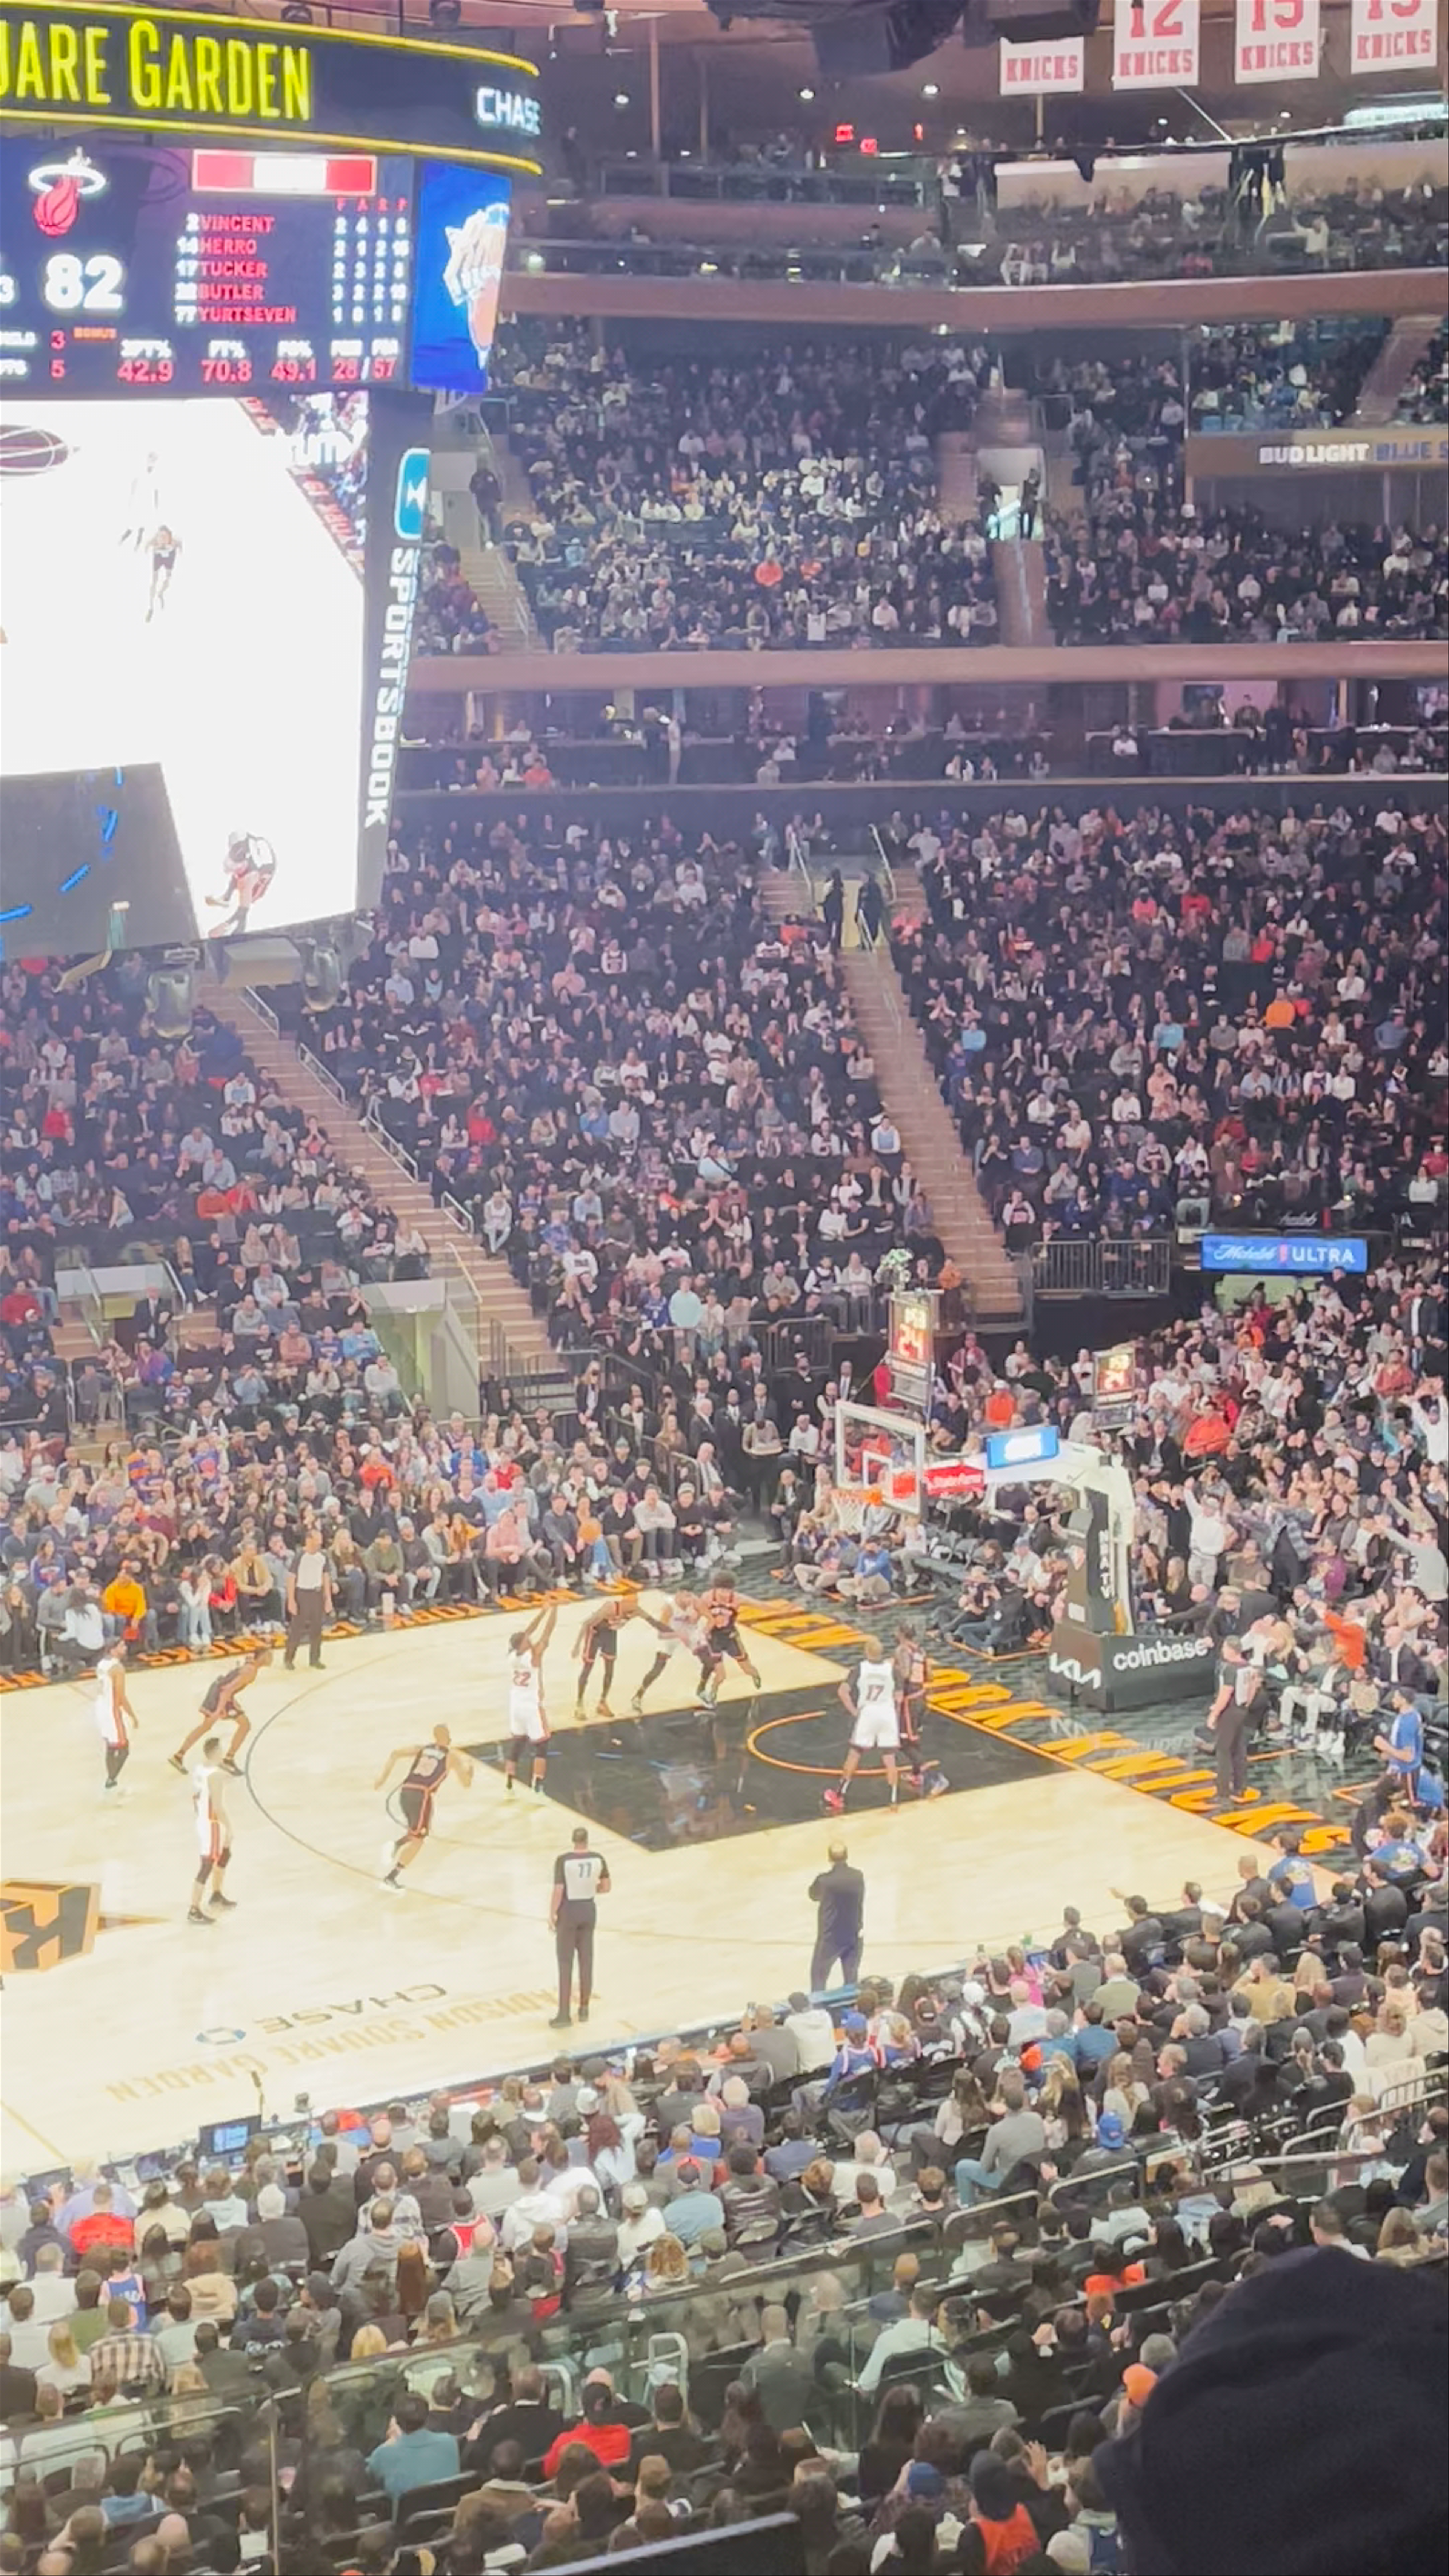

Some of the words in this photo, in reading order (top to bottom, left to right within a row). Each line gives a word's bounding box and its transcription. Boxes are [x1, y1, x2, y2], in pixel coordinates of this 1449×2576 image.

[1241, 42, 1313, 71] KNICKS
[1356, 29, 1431, 60] KNICKS
[0, 20, 111, 105] ARE
[129, 20, 311, 120] GARDEN
[1006, 55, 1077, 82] KNICKS
[1120, 49, 1192, 76] KNICKS
[200, 214, 274, 233] VINCENT
[200, 237, 257, 255] HERRO
[45, 253, 122, 308] 82
[200, 260, 268, 278] TUCKER
[199, 283, 265, 301] BUTLER
[198, 306, 295, 324] YURTSEVEN
[117, 359, 172, 382] 42.9
[201, 359, 252, 382] 70.8
[271, 358, 316, 381] 49.1
[1260, 446, 1304, 464] BUD
[1306, 443, 1369, 462] LIGHT
[364, 546, 417, 829] SPORTSBOOK
[1292, 1247, 1357, 1263] ULTRA
[1113, 1635, 1209, 1671] coinbase
[254, 1984, 447, 2033] CHASE
